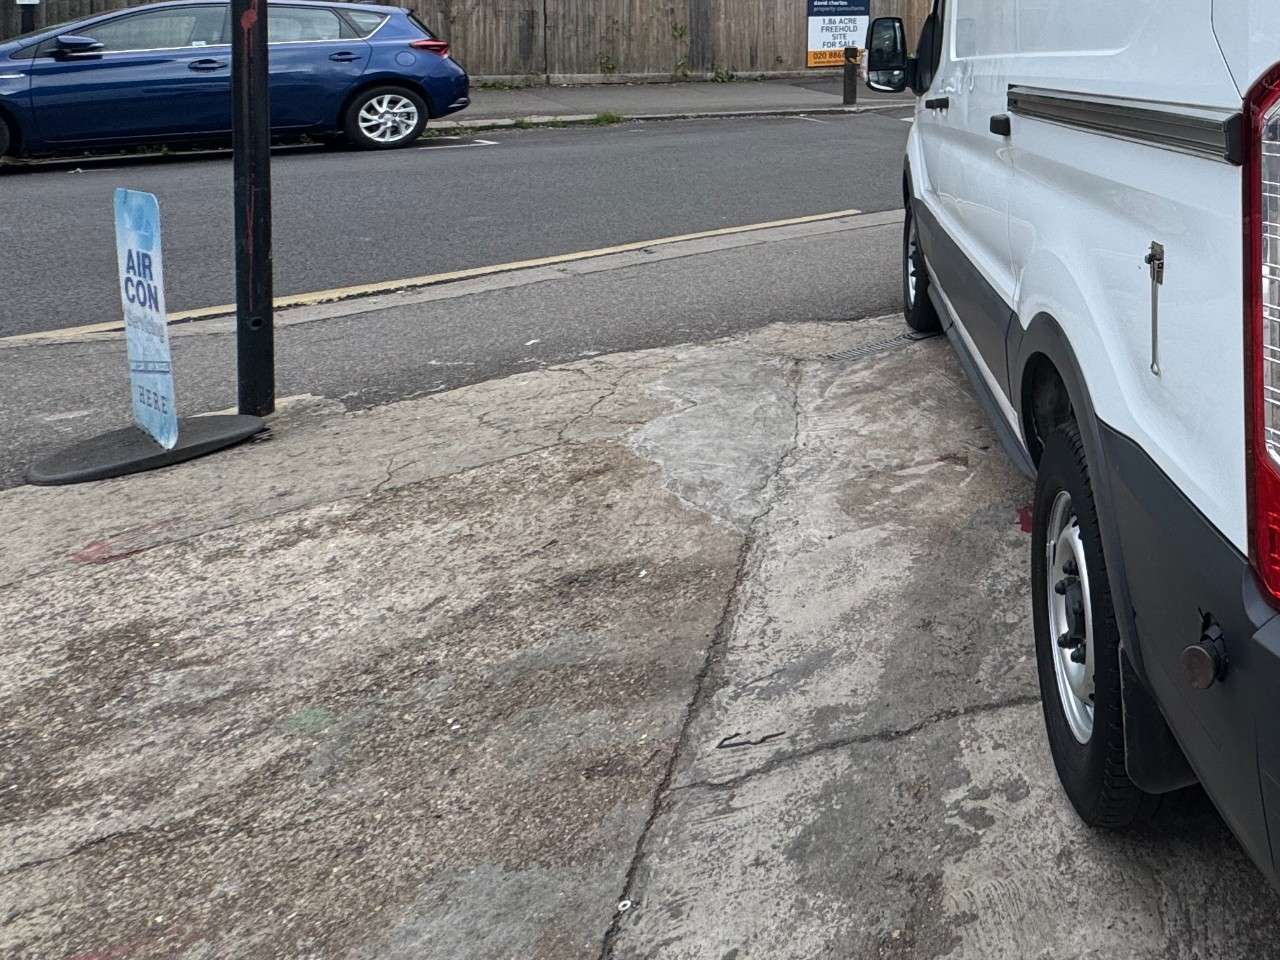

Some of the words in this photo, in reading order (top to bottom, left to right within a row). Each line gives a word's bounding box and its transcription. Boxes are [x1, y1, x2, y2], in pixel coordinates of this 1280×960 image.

[838, 17, 858, 25] ACRE
[821, 25, 858, 33] FREEHOLD
[831, 33, 848, 41] SITE
[822, 41, 837, 49] FOR
[838, 40, 857, 48] SALE
[125, 248, 153, 281] AIR
[124, 276, 160, 313] CON
[137, 384, 168, 415] HERE
